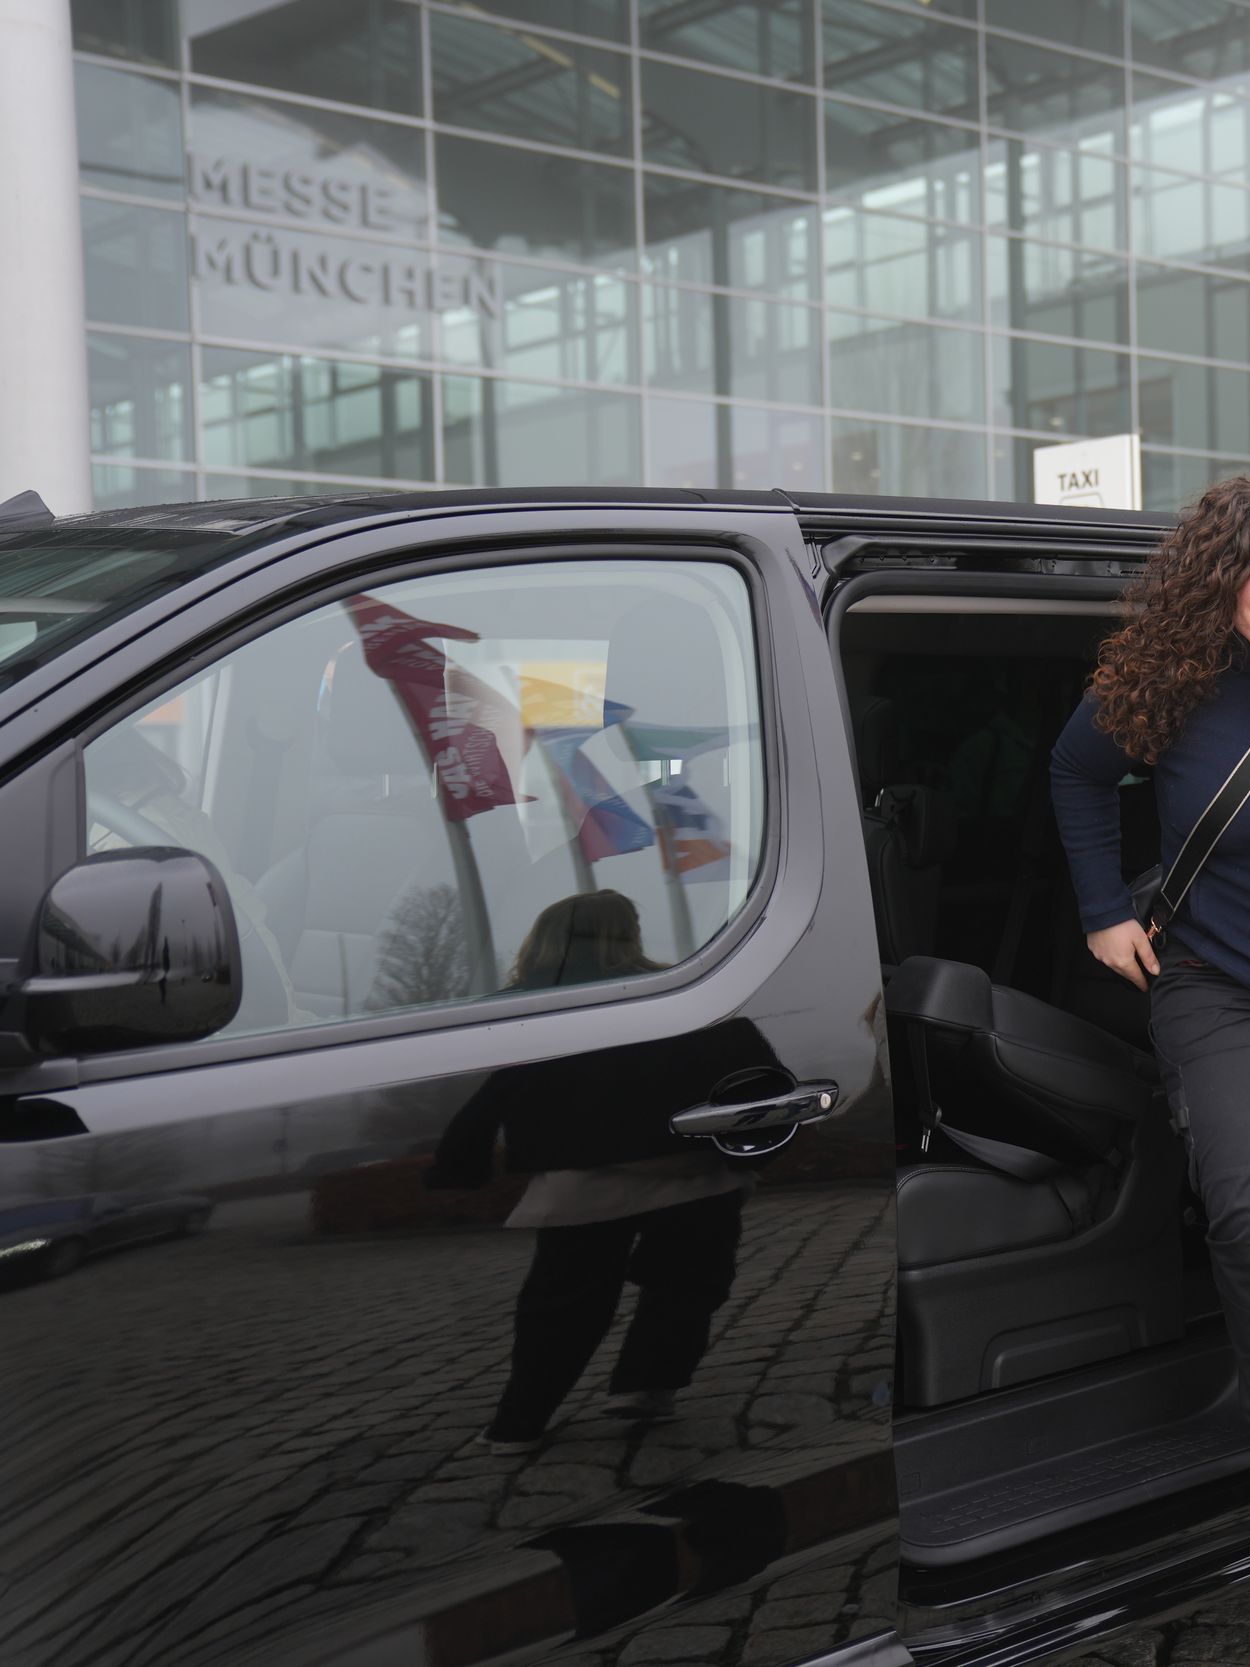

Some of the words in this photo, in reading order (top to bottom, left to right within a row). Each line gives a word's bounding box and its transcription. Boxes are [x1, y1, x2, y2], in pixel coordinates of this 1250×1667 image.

[187, 153, 398, 231] MESSE
[190, 231, 500, 320] MÜNCHEN
[1057, 469, 1099, 491] TAXI
